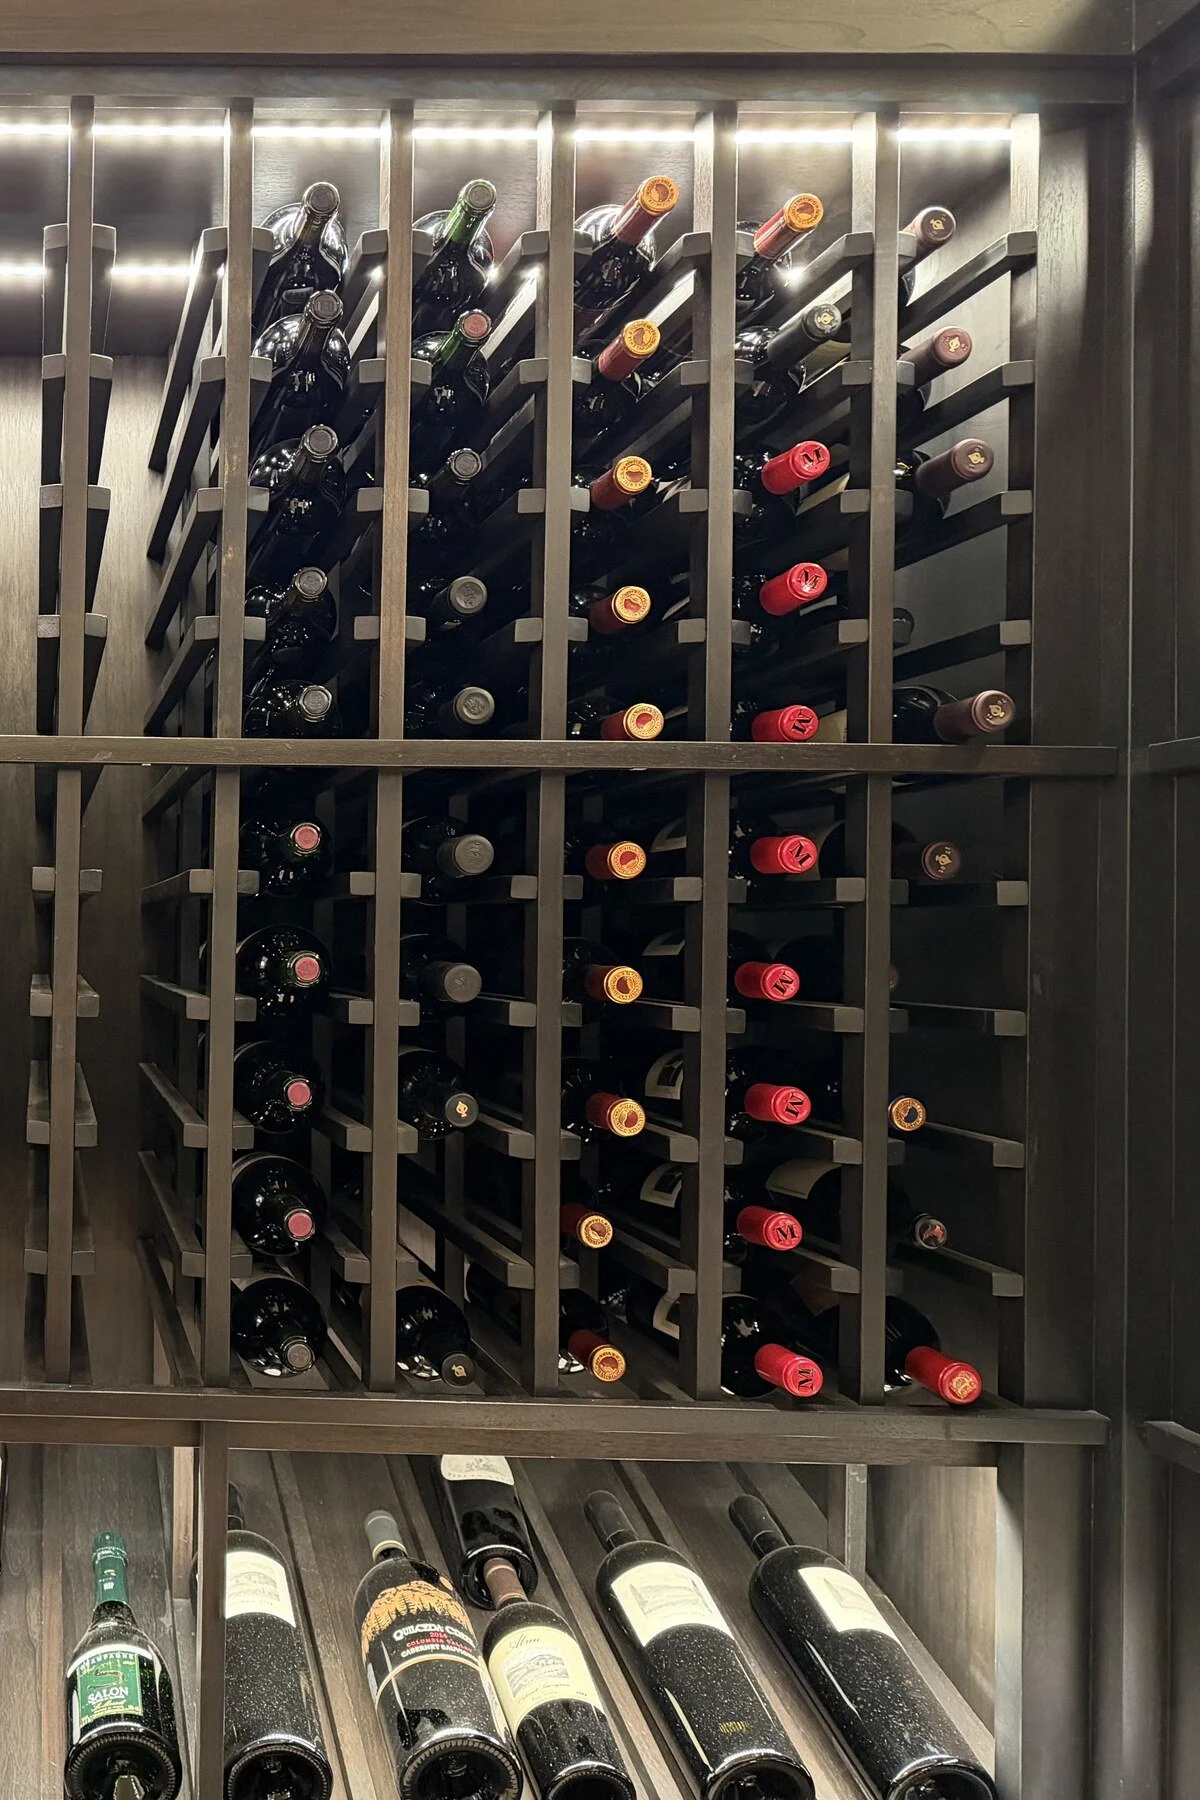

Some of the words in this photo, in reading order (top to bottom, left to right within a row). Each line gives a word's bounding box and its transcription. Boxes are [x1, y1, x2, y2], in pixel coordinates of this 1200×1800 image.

[799, 449, 827, 469] M
[797, 568, 820, 591] M
[791, 714, 813, 737] M
[788, 842, 812, 868] M
[772, 970, 796, 995] M
[785, 1095, 806, 1118] M
[775, 1224, 798, 1243] M
[797, 1368, 815, 1391] M
[401, 1644, 440, 1658] CABERNET
[406, 1638, 445, 1648] COLUMBIA
[88, 1686, 129, 1704] SALON
